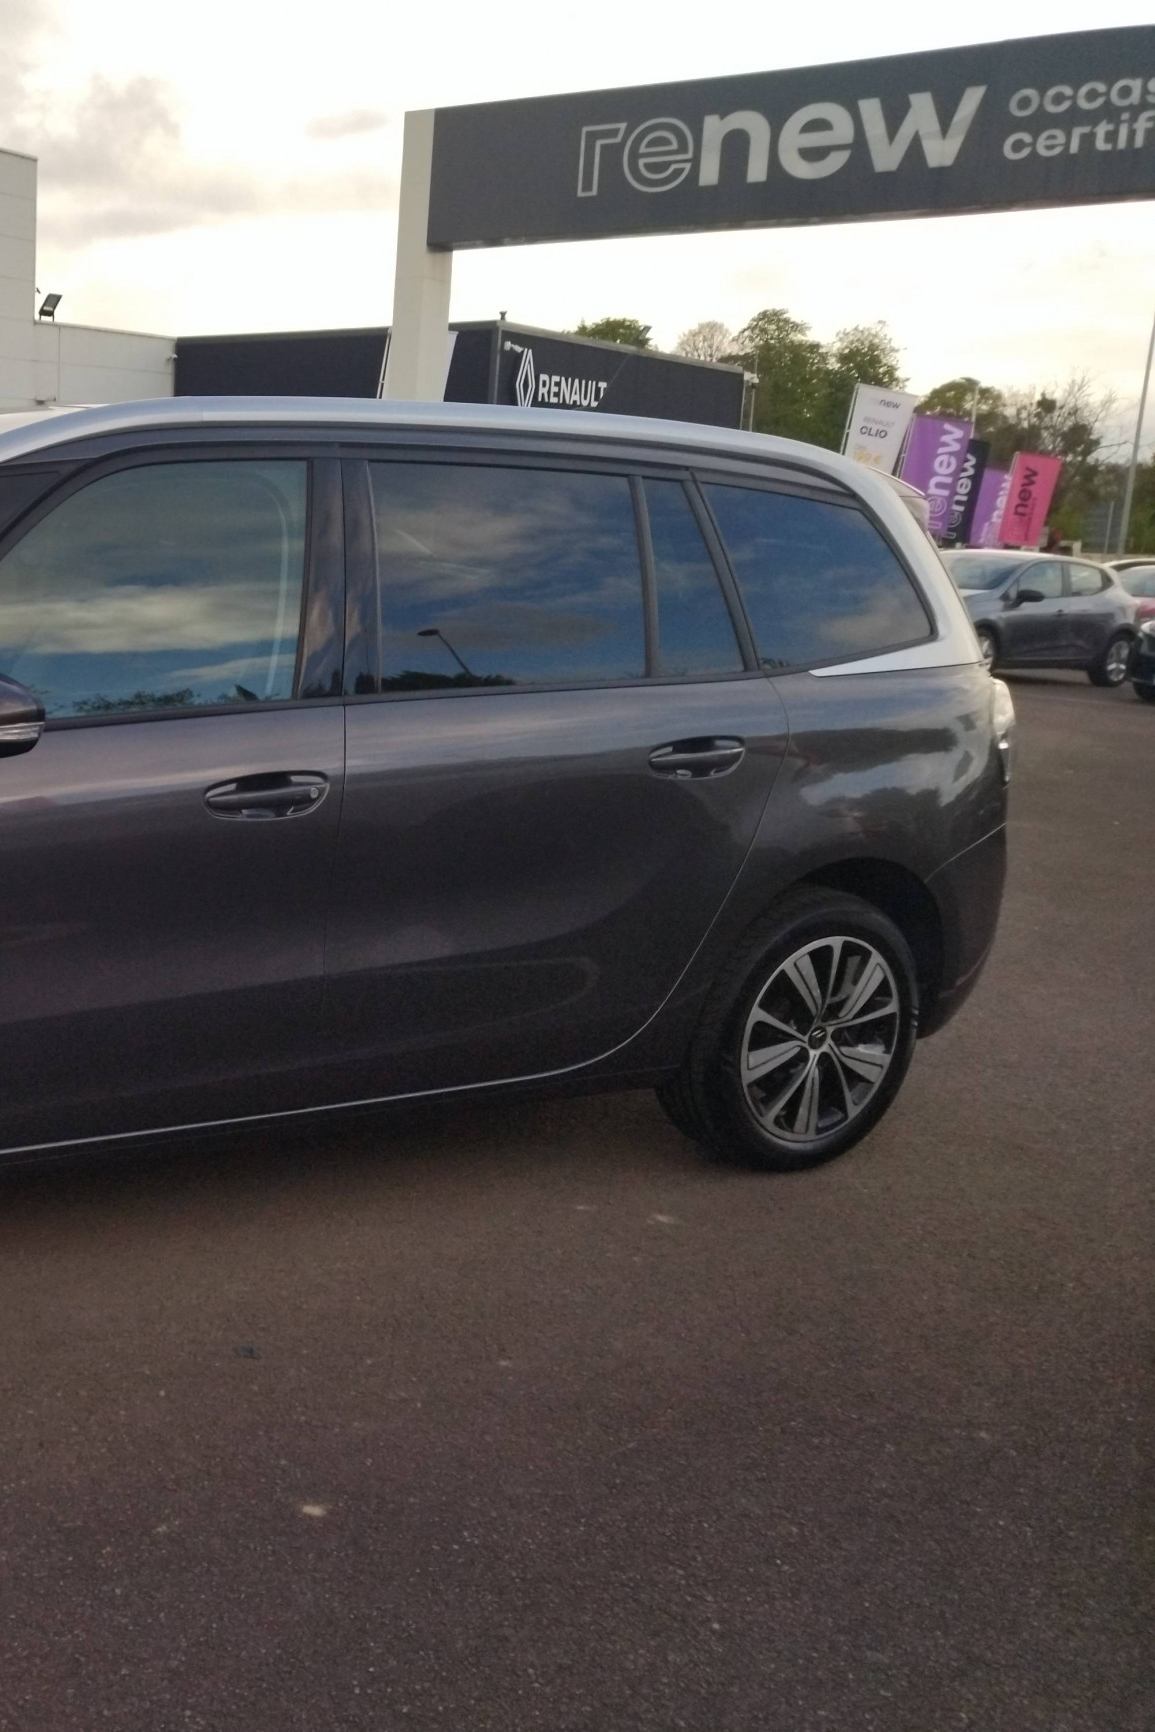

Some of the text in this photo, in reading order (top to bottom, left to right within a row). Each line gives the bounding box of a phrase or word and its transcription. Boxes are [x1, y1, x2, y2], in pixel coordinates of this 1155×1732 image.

[577, 85, 987, 197] renew
[538, 373, 607, 408] RENAULT
[859, 426, 888, 439] CLIO
